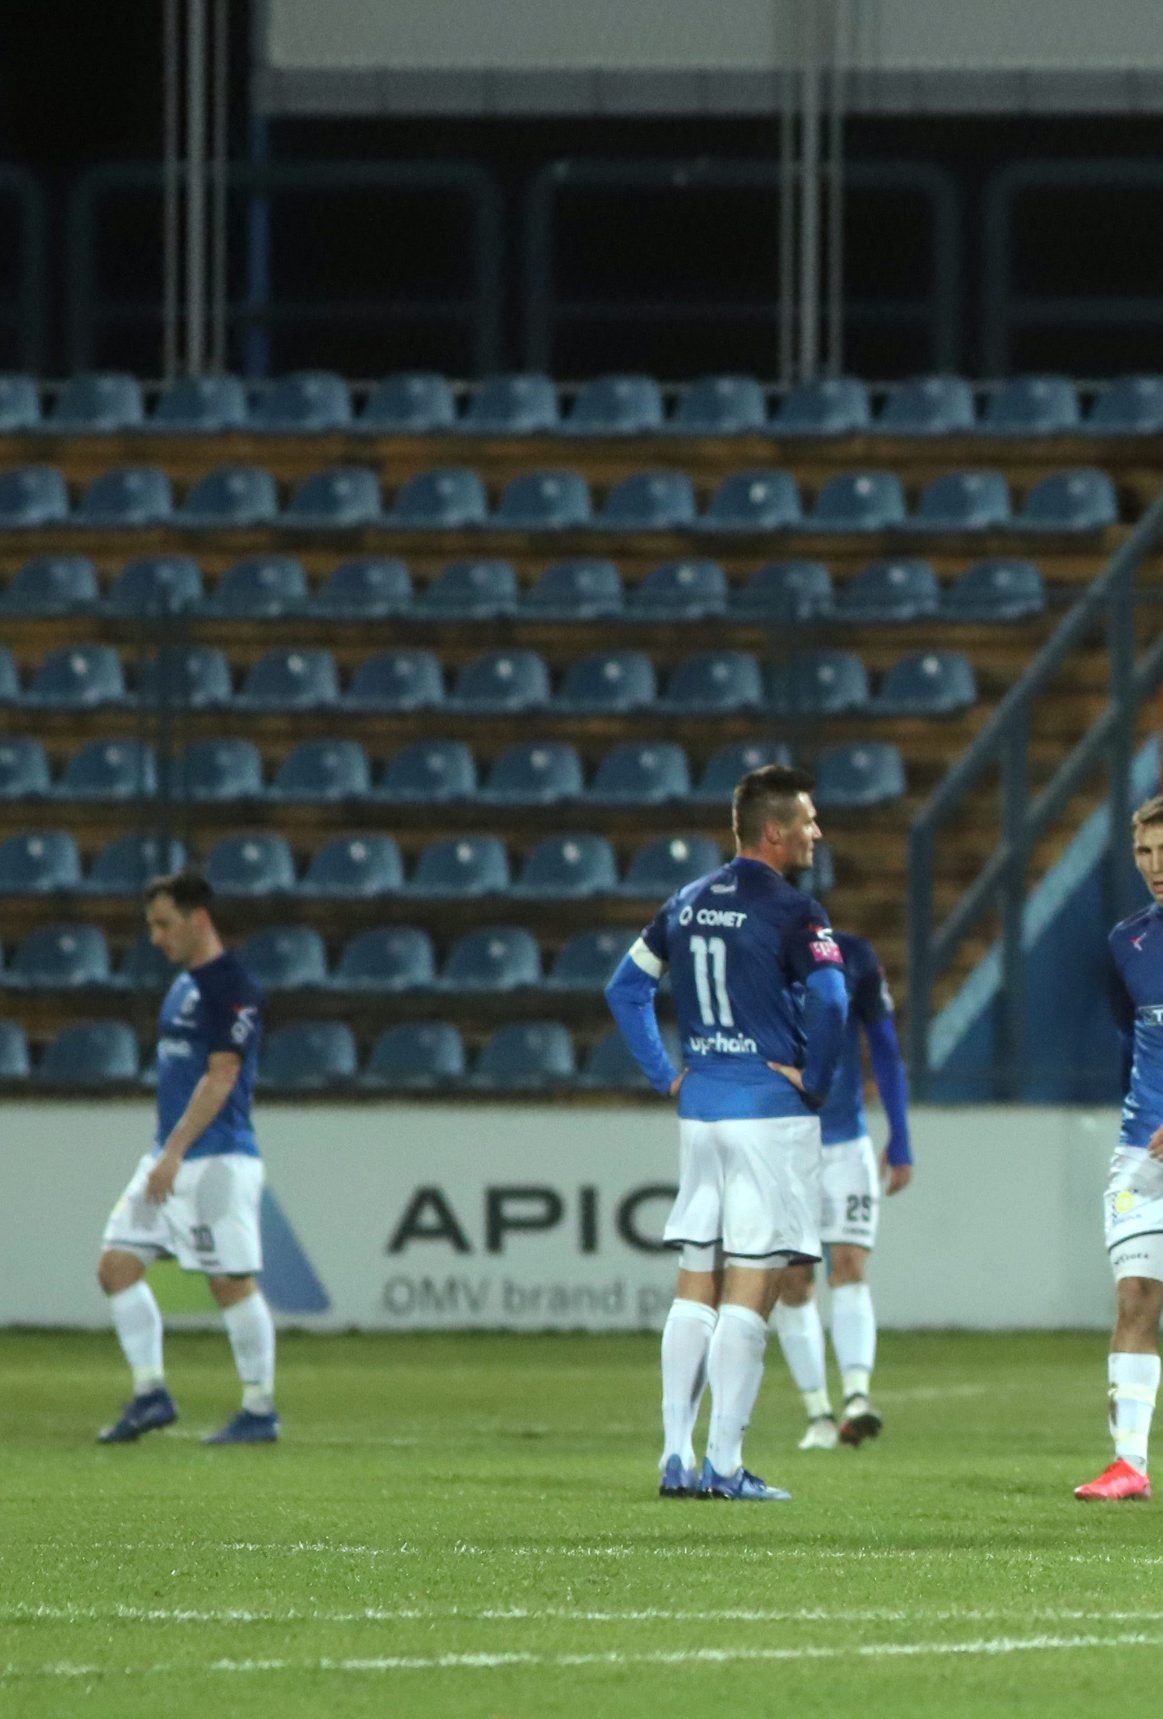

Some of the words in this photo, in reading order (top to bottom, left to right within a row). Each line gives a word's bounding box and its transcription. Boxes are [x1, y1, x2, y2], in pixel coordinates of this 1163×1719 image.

[696, 908, 747, 928] COMET
[689, 935, 735, 1027] 11
[384, 1275, 490, 1317] OMV
[503, 1277, 626, 1316] brand
